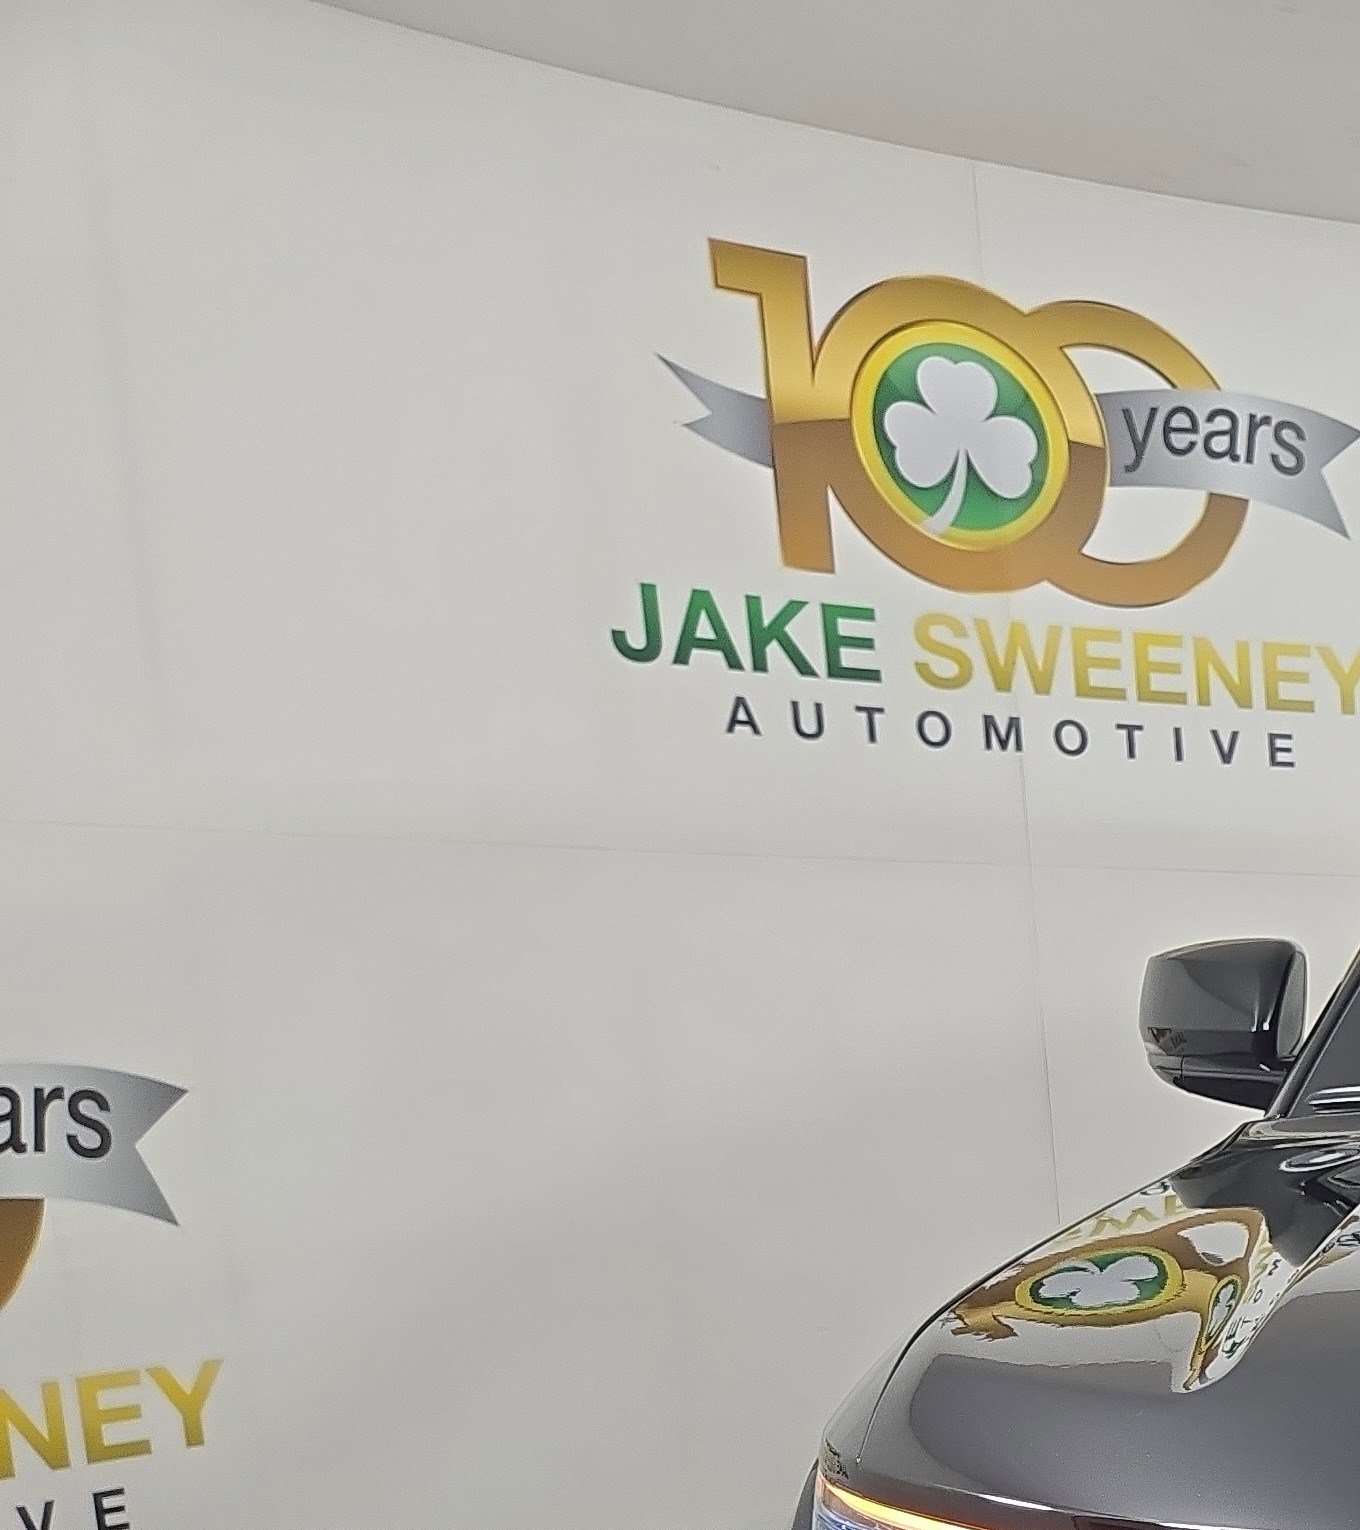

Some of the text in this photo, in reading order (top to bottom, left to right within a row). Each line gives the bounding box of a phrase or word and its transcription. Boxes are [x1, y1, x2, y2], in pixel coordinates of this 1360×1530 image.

[1121, 402, 1307, 477] years
[611, 582, 882, 683] JAKE
[725, 696, 1296, 768] AUTOMOTIVE
